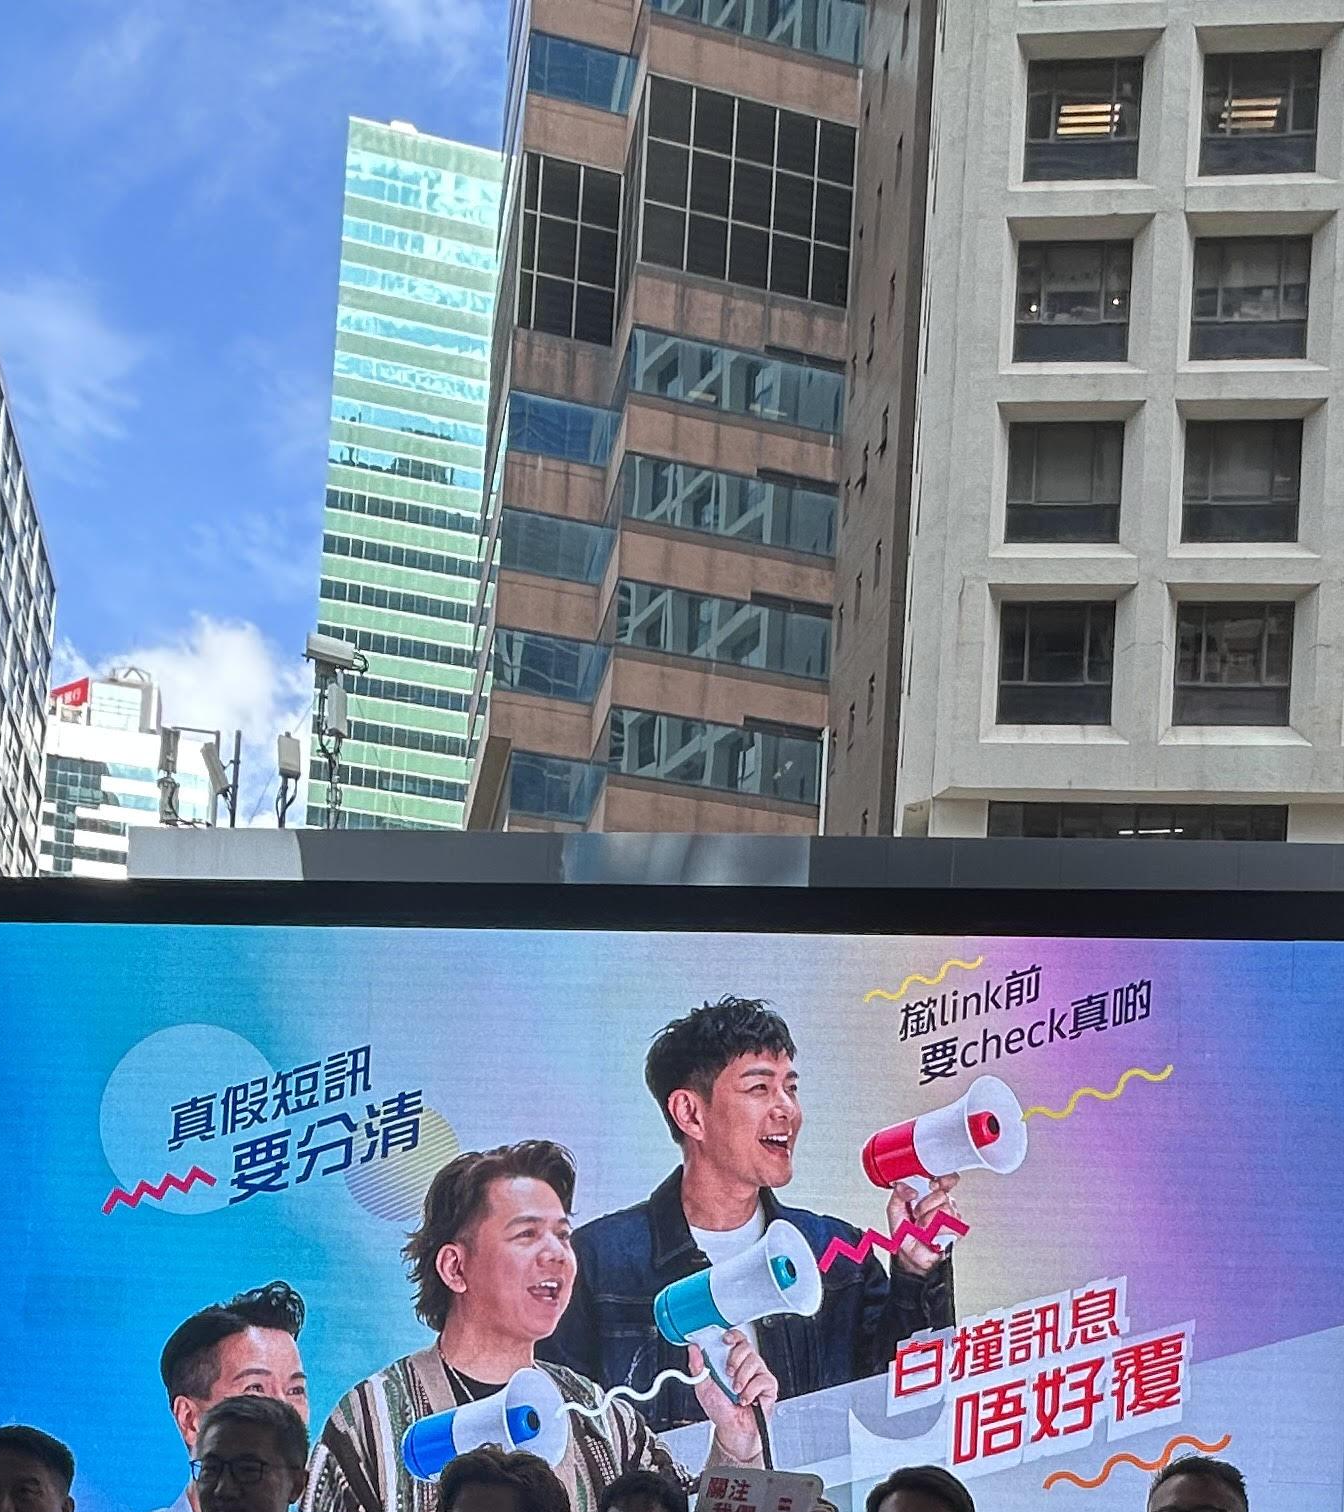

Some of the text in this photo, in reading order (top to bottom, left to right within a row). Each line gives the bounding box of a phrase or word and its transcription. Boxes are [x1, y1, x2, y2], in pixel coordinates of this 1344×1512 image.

[168, 1044, 372, 1152] 真假短訊
[228, 1089, 424, 1206] 要分清
[894, 1285, 1120, 1400] 白撞訊息
[951, 1332, 1186, 1466] 唔好覆
